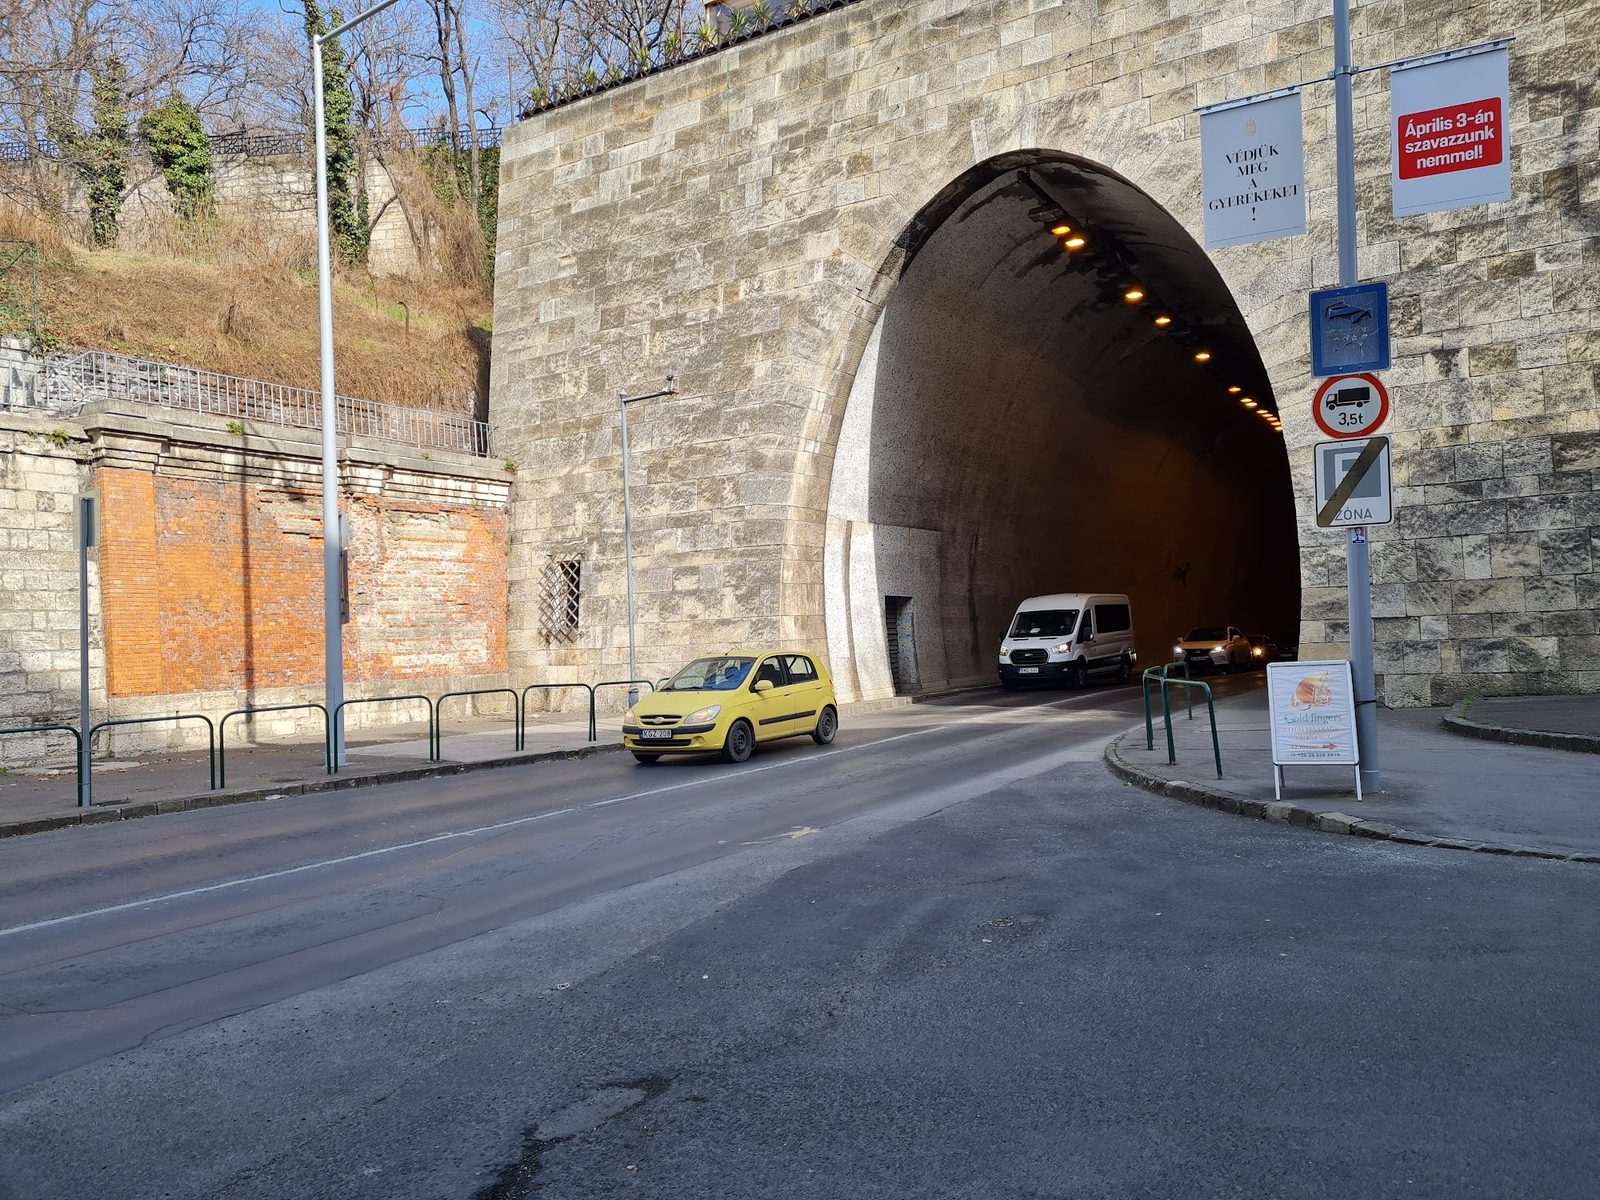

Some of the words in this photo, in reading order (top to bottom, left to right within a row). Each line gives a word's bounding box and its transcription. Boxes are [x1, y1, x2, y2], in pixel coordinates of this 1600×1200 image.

[1405, 117, 1453, 138] Április
[1456, 110, 1494, 127] 3-án
[1405, 125, 1495, 153] szavazzunk
[1226, 144, 1279, 164] VÉDJÜK
[1416, 145, 1483, 169] nemmel!
[1238, 161, 1268, 177] MEG
[1248, 179, 1258, 190] A
[1209, 184, 1300, 211] GYEREKEKET
[1251, 207, 1256, 221] !
[1284, 713, 1308, 724] Gold
[1311, 712, 1342, 724] fingers
